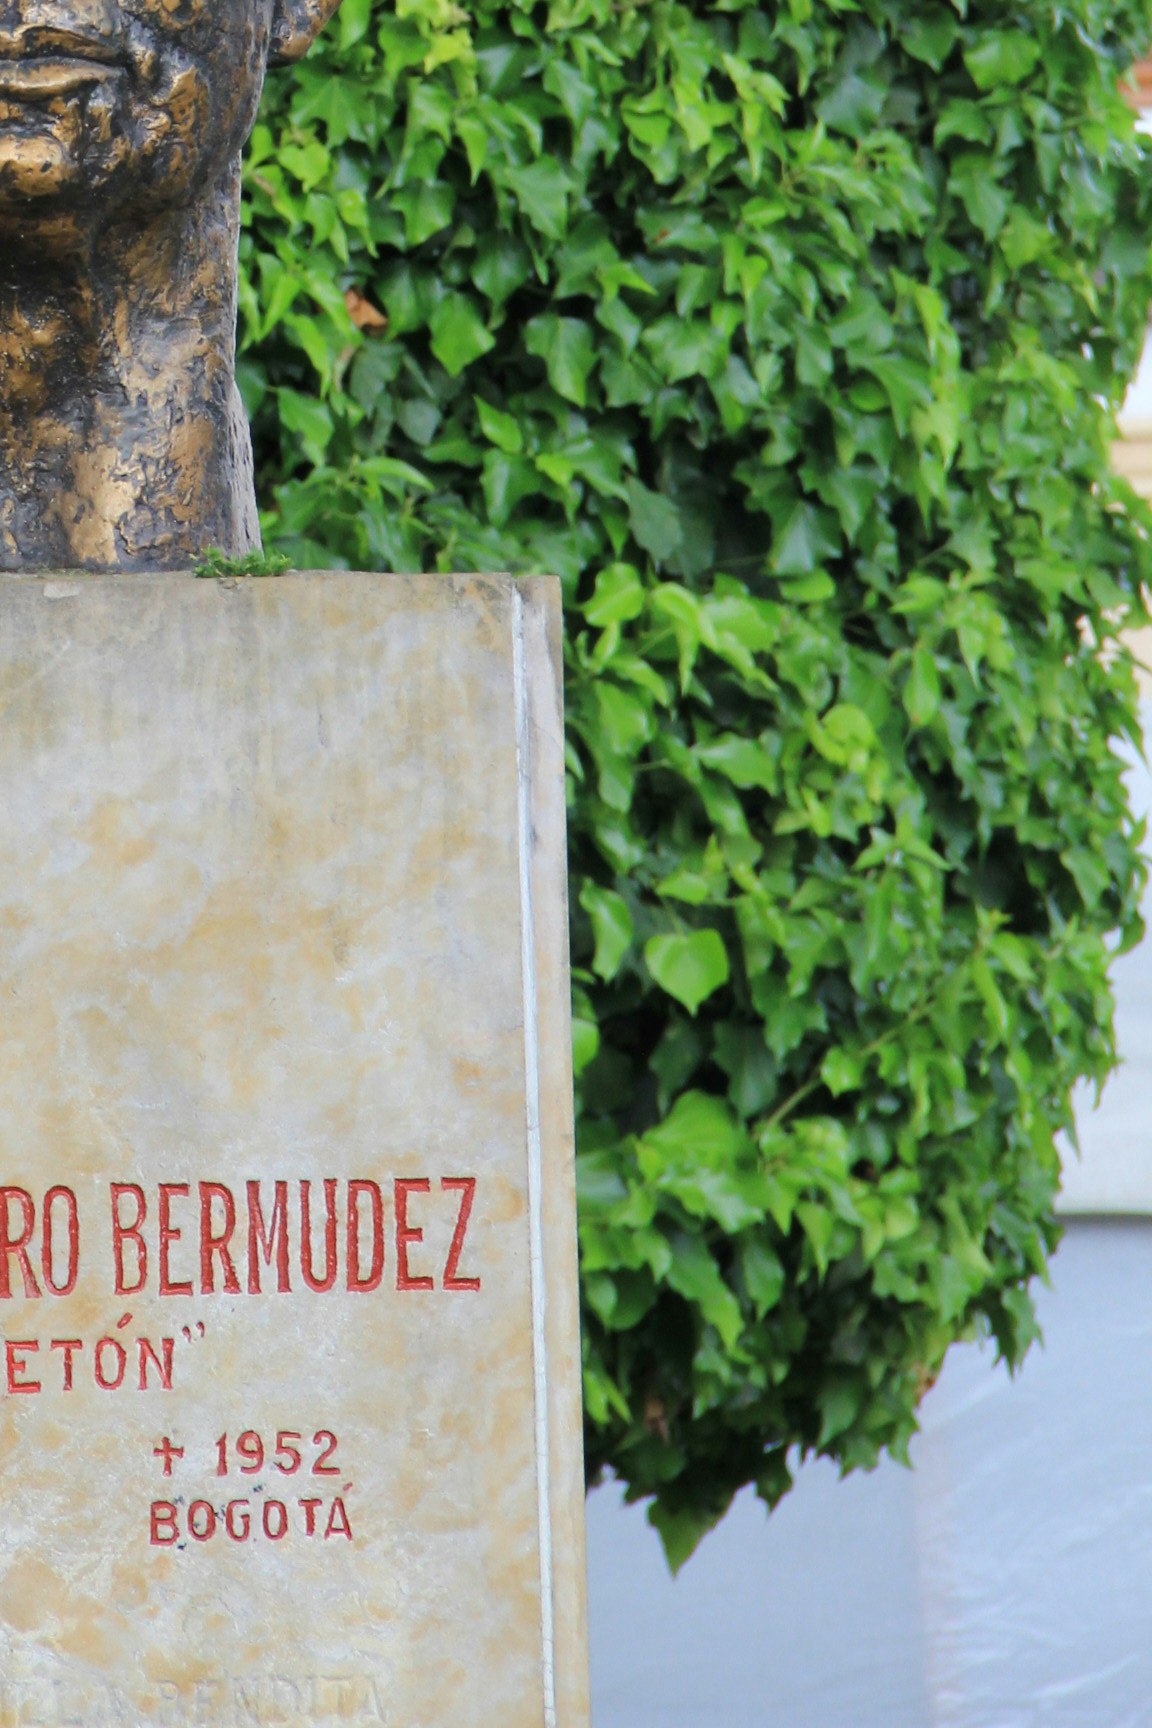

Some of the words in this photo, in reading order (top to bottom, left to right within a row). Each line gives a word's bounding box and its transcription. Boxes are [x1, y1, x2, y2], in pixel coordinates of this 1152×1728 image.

[109, 1176, 481, 1296] BERMUDEZ
[215, 1429, 341, 1476] 1952
[149, 1483, 353, 1546] BOGOTÁ
